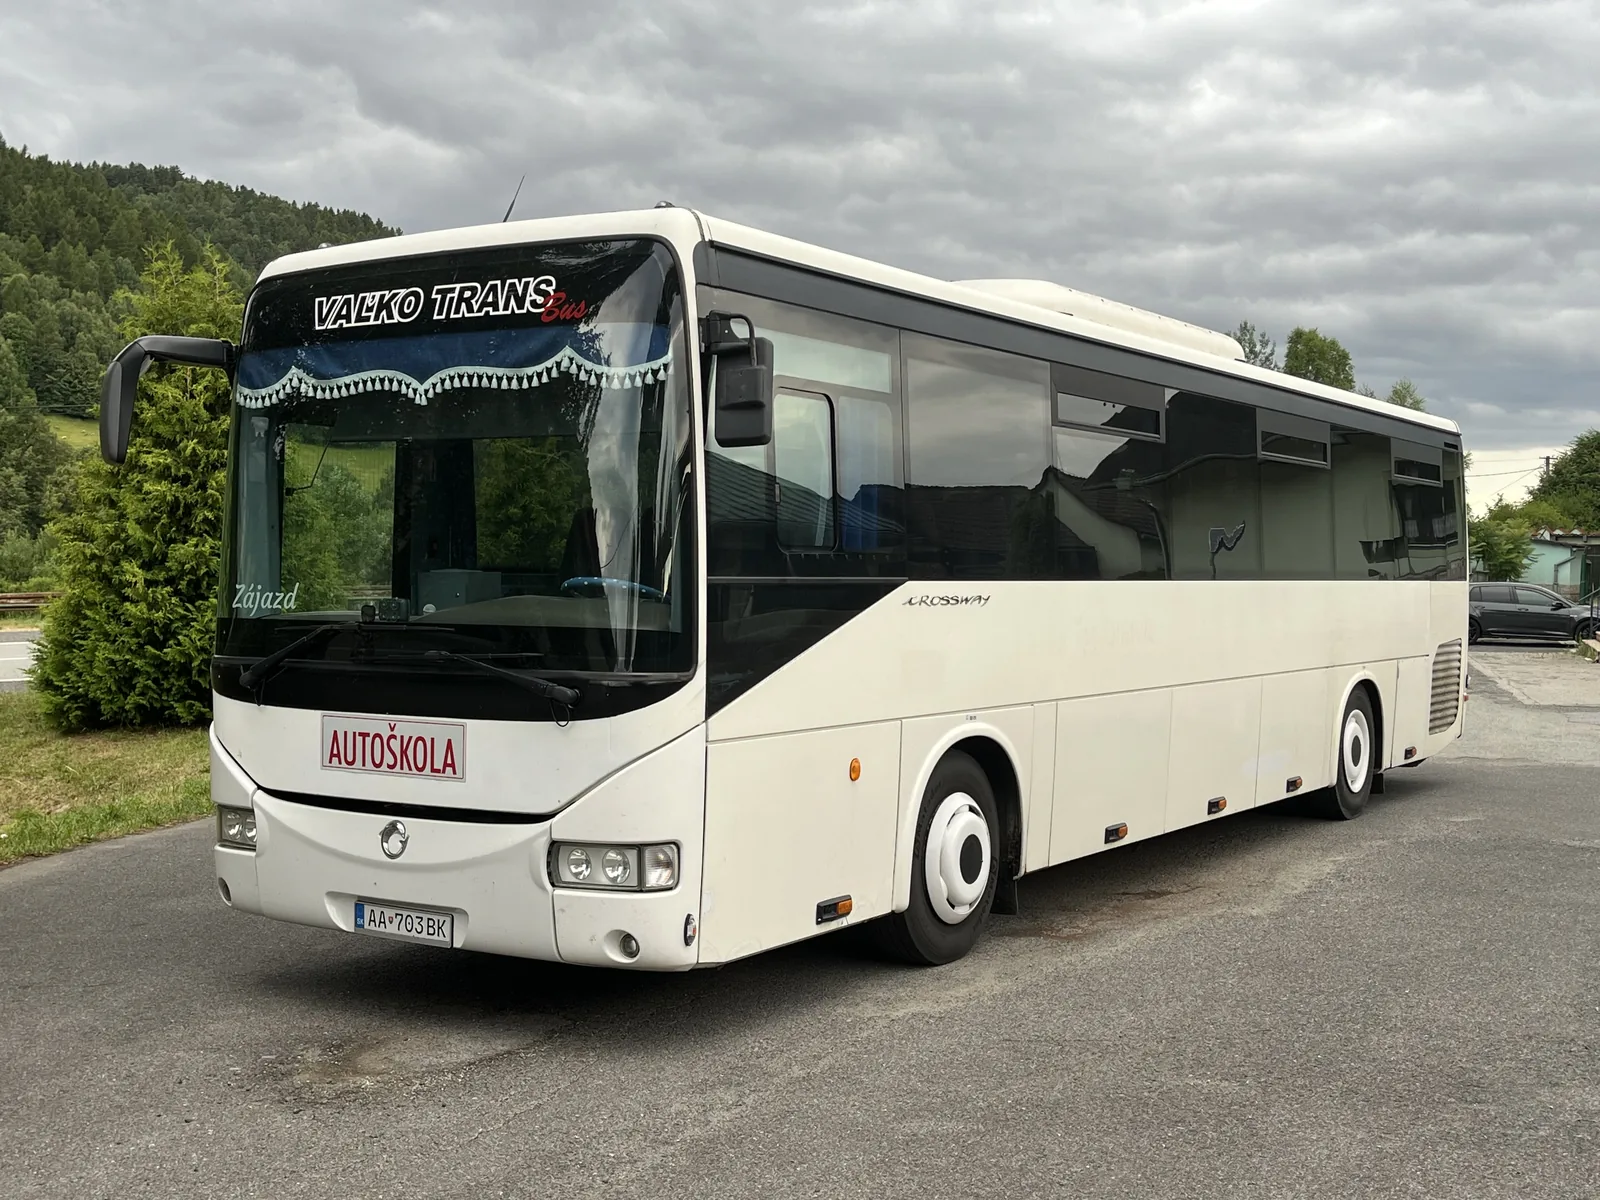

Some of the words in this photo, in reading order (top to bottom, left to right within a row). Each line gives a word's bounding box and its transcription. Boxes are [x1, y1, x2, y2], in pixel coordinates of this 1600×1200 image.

[431, 275, 556, 320] TRANS
[540, 292, 588, 323] Bus
[231, 582, 300, 617] Zájazd
[902, 594, 991, 608] CROSSWAY
[328, 722, 457, 775] AUTOŠKOLA
